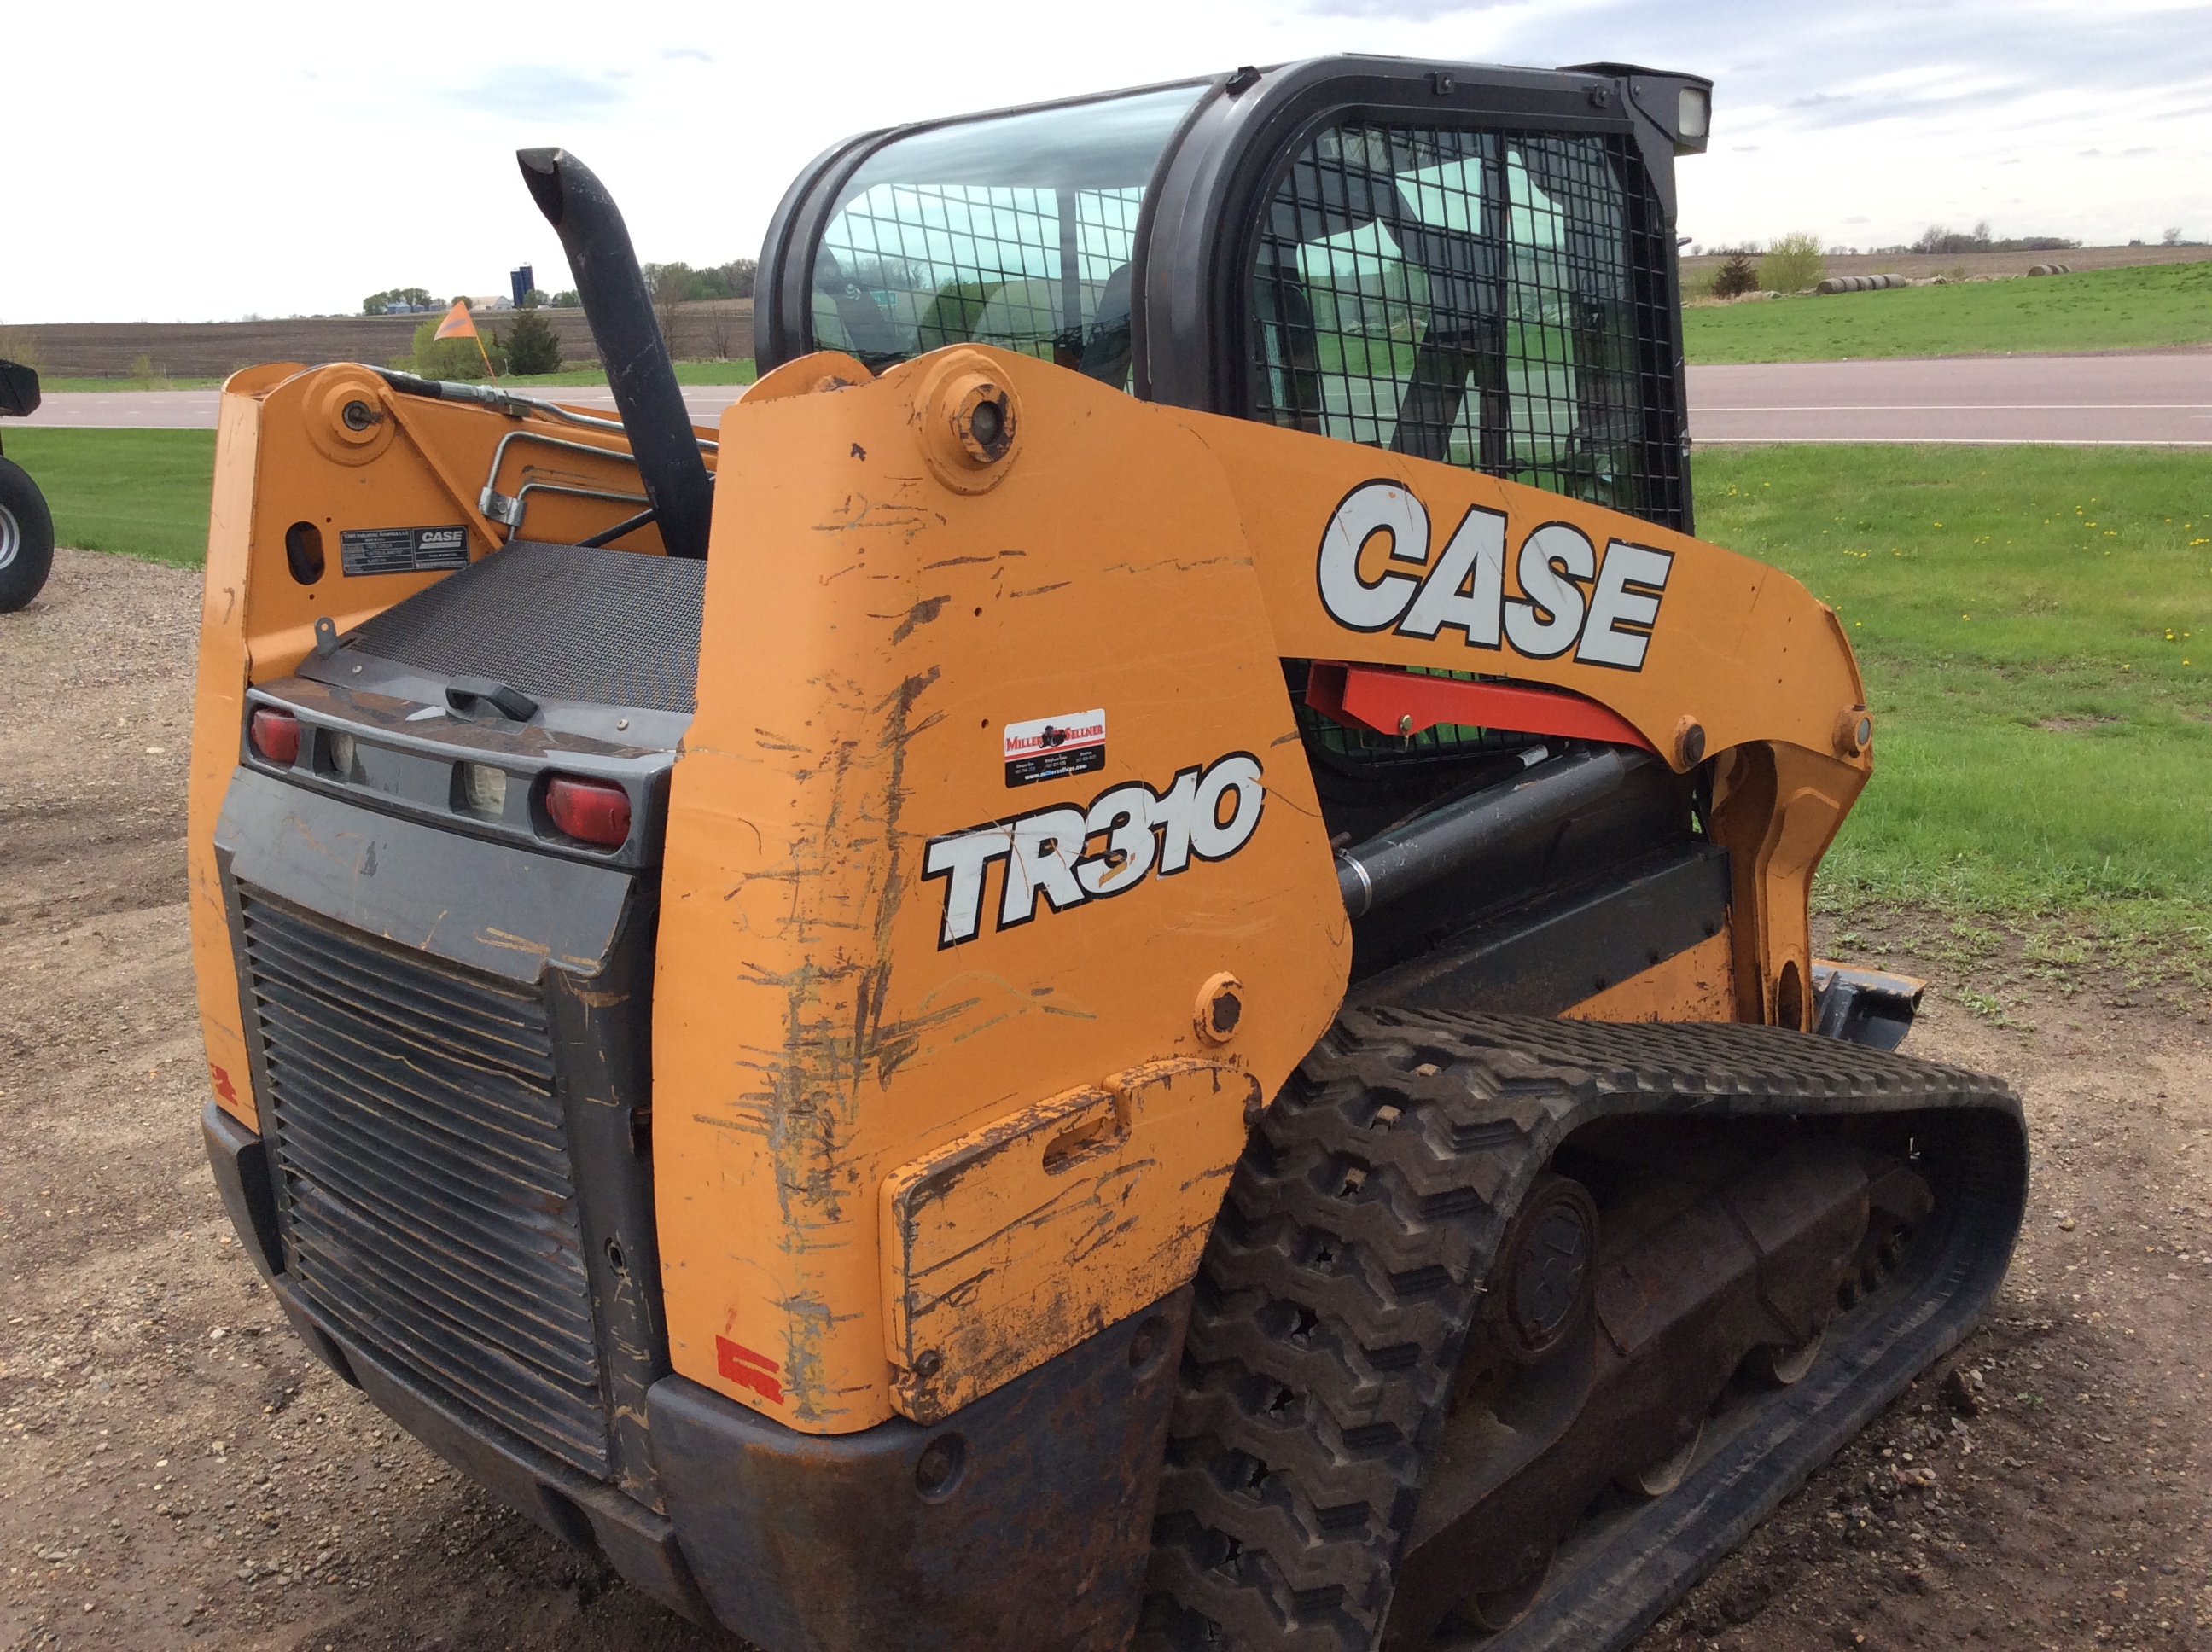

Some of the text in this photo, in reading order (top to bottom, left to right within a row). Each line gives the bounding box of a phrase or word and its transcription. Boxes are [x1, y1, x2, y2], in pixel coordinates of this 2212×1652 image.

[422, 530, 463, 542] CASE
[1316, 477, 1676, 672] CASE
[1006, 724, 1104, 751] MILLER SELLNER
[921, 751, 1266, 951] TR310
